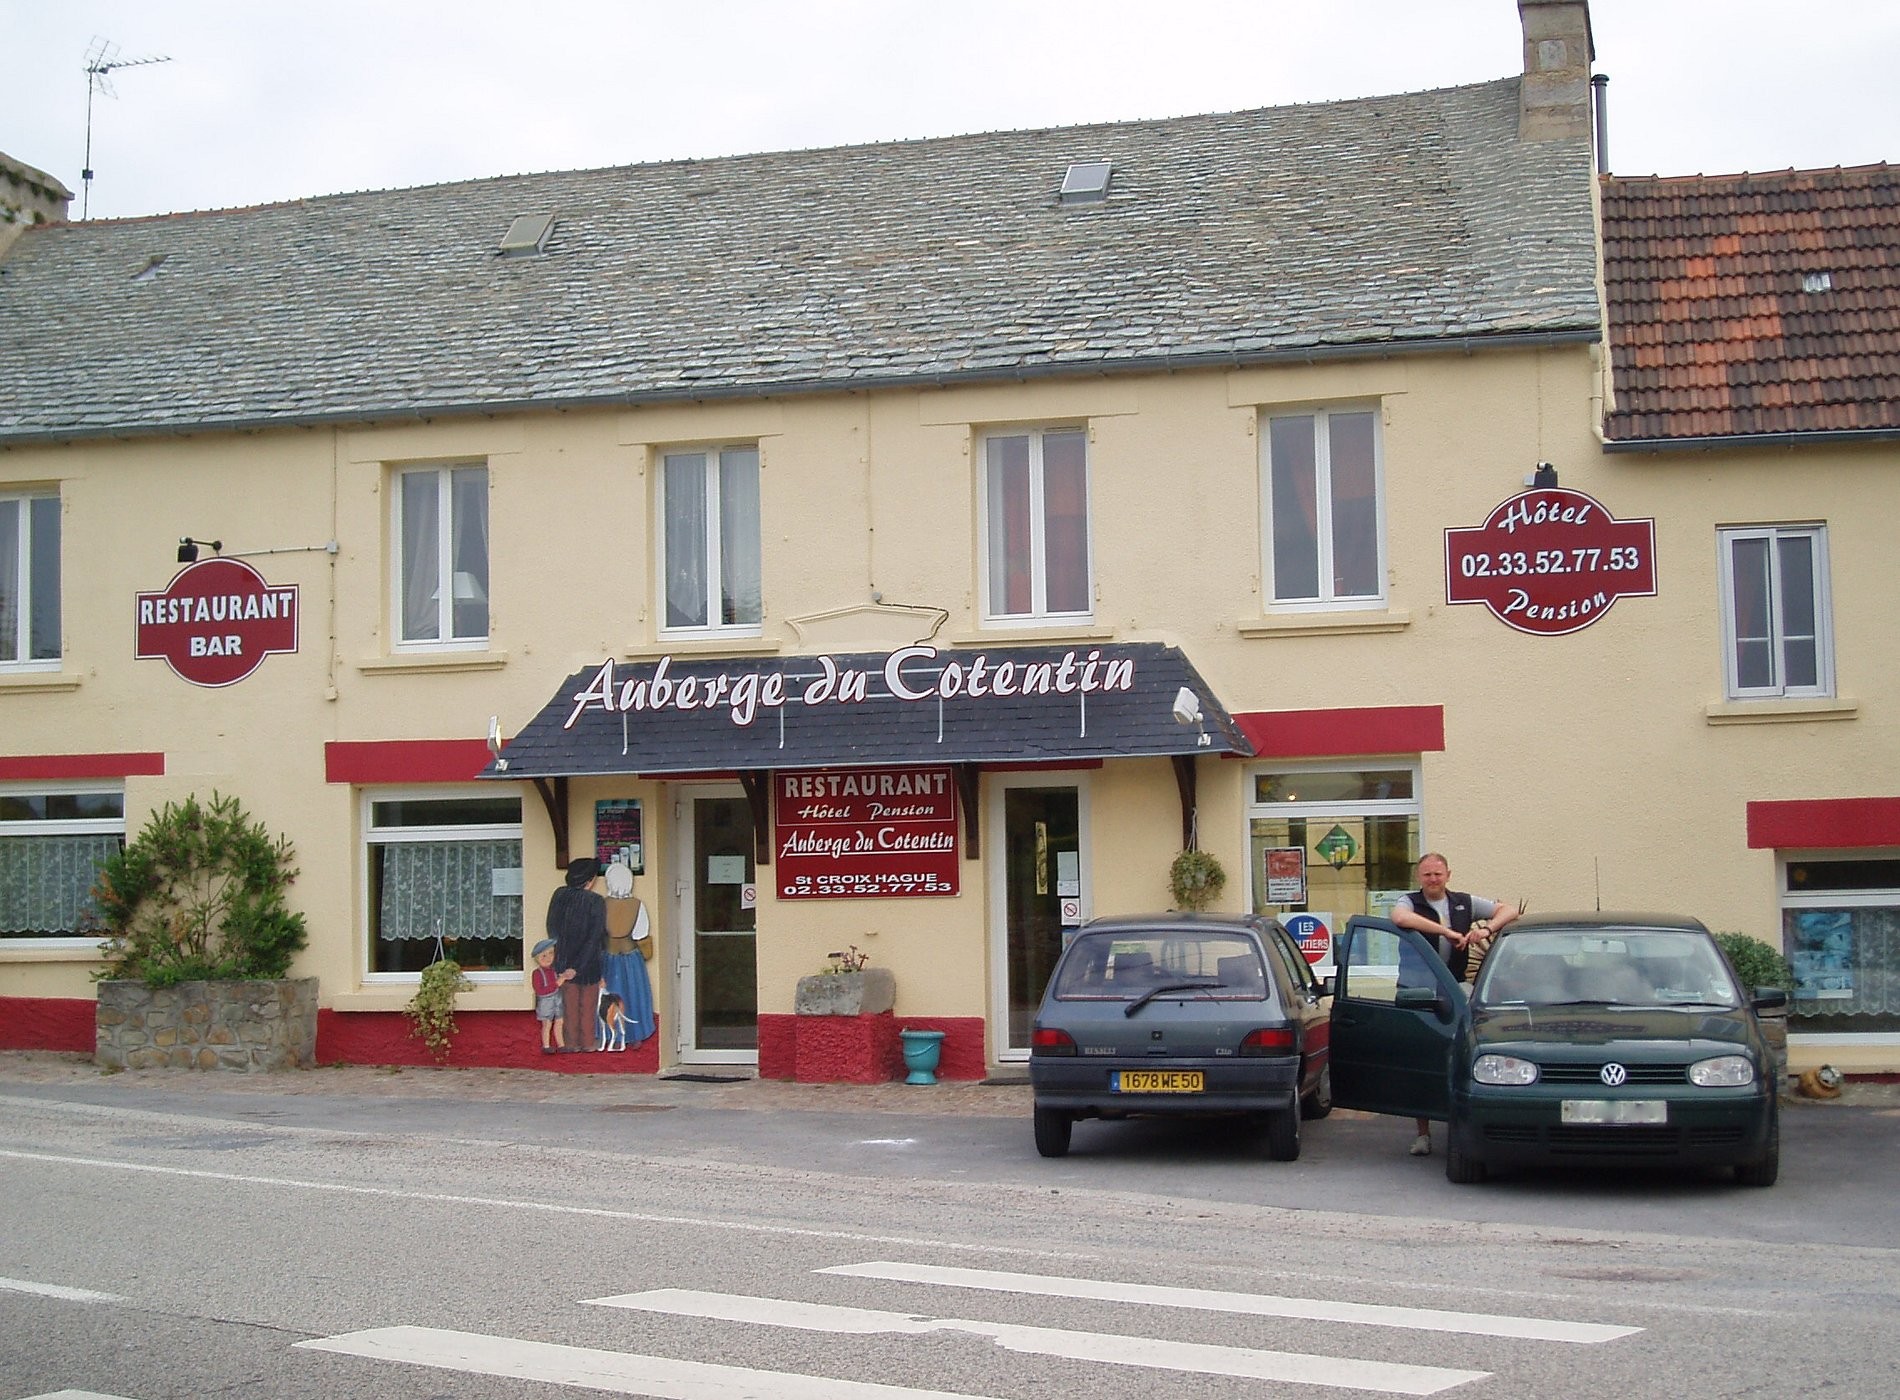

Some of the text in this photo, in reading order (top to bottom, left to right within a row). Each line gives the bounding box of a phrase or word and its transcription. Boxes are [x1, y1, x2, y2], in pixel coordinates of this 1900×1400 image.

[1497, 499, 1592, 534] Hôtel
[1461, 546, 1640, 577] 02.33.52.77.53
[140, 592, 293, 625] RESTAURANT
[1502, 588, 1607, 620] Pension
[190, 635, 242, 657] BAR
[563, 645, 1134, 730] Auberge du Cotentin
[785, 773, 947, 798] RESTAURANT
[797, 802, 934, 821] Hôtel Pension
[780, 827, 953, 859] Auberge du Cotentin
[784, 883, 952, 895] 02.33.52.77.53
[795, 873, 938, 885] St CROIX HAGUE
[1298, 921, 1314, 935] LES
[1295, 938, 1329, 950] UTIERS
